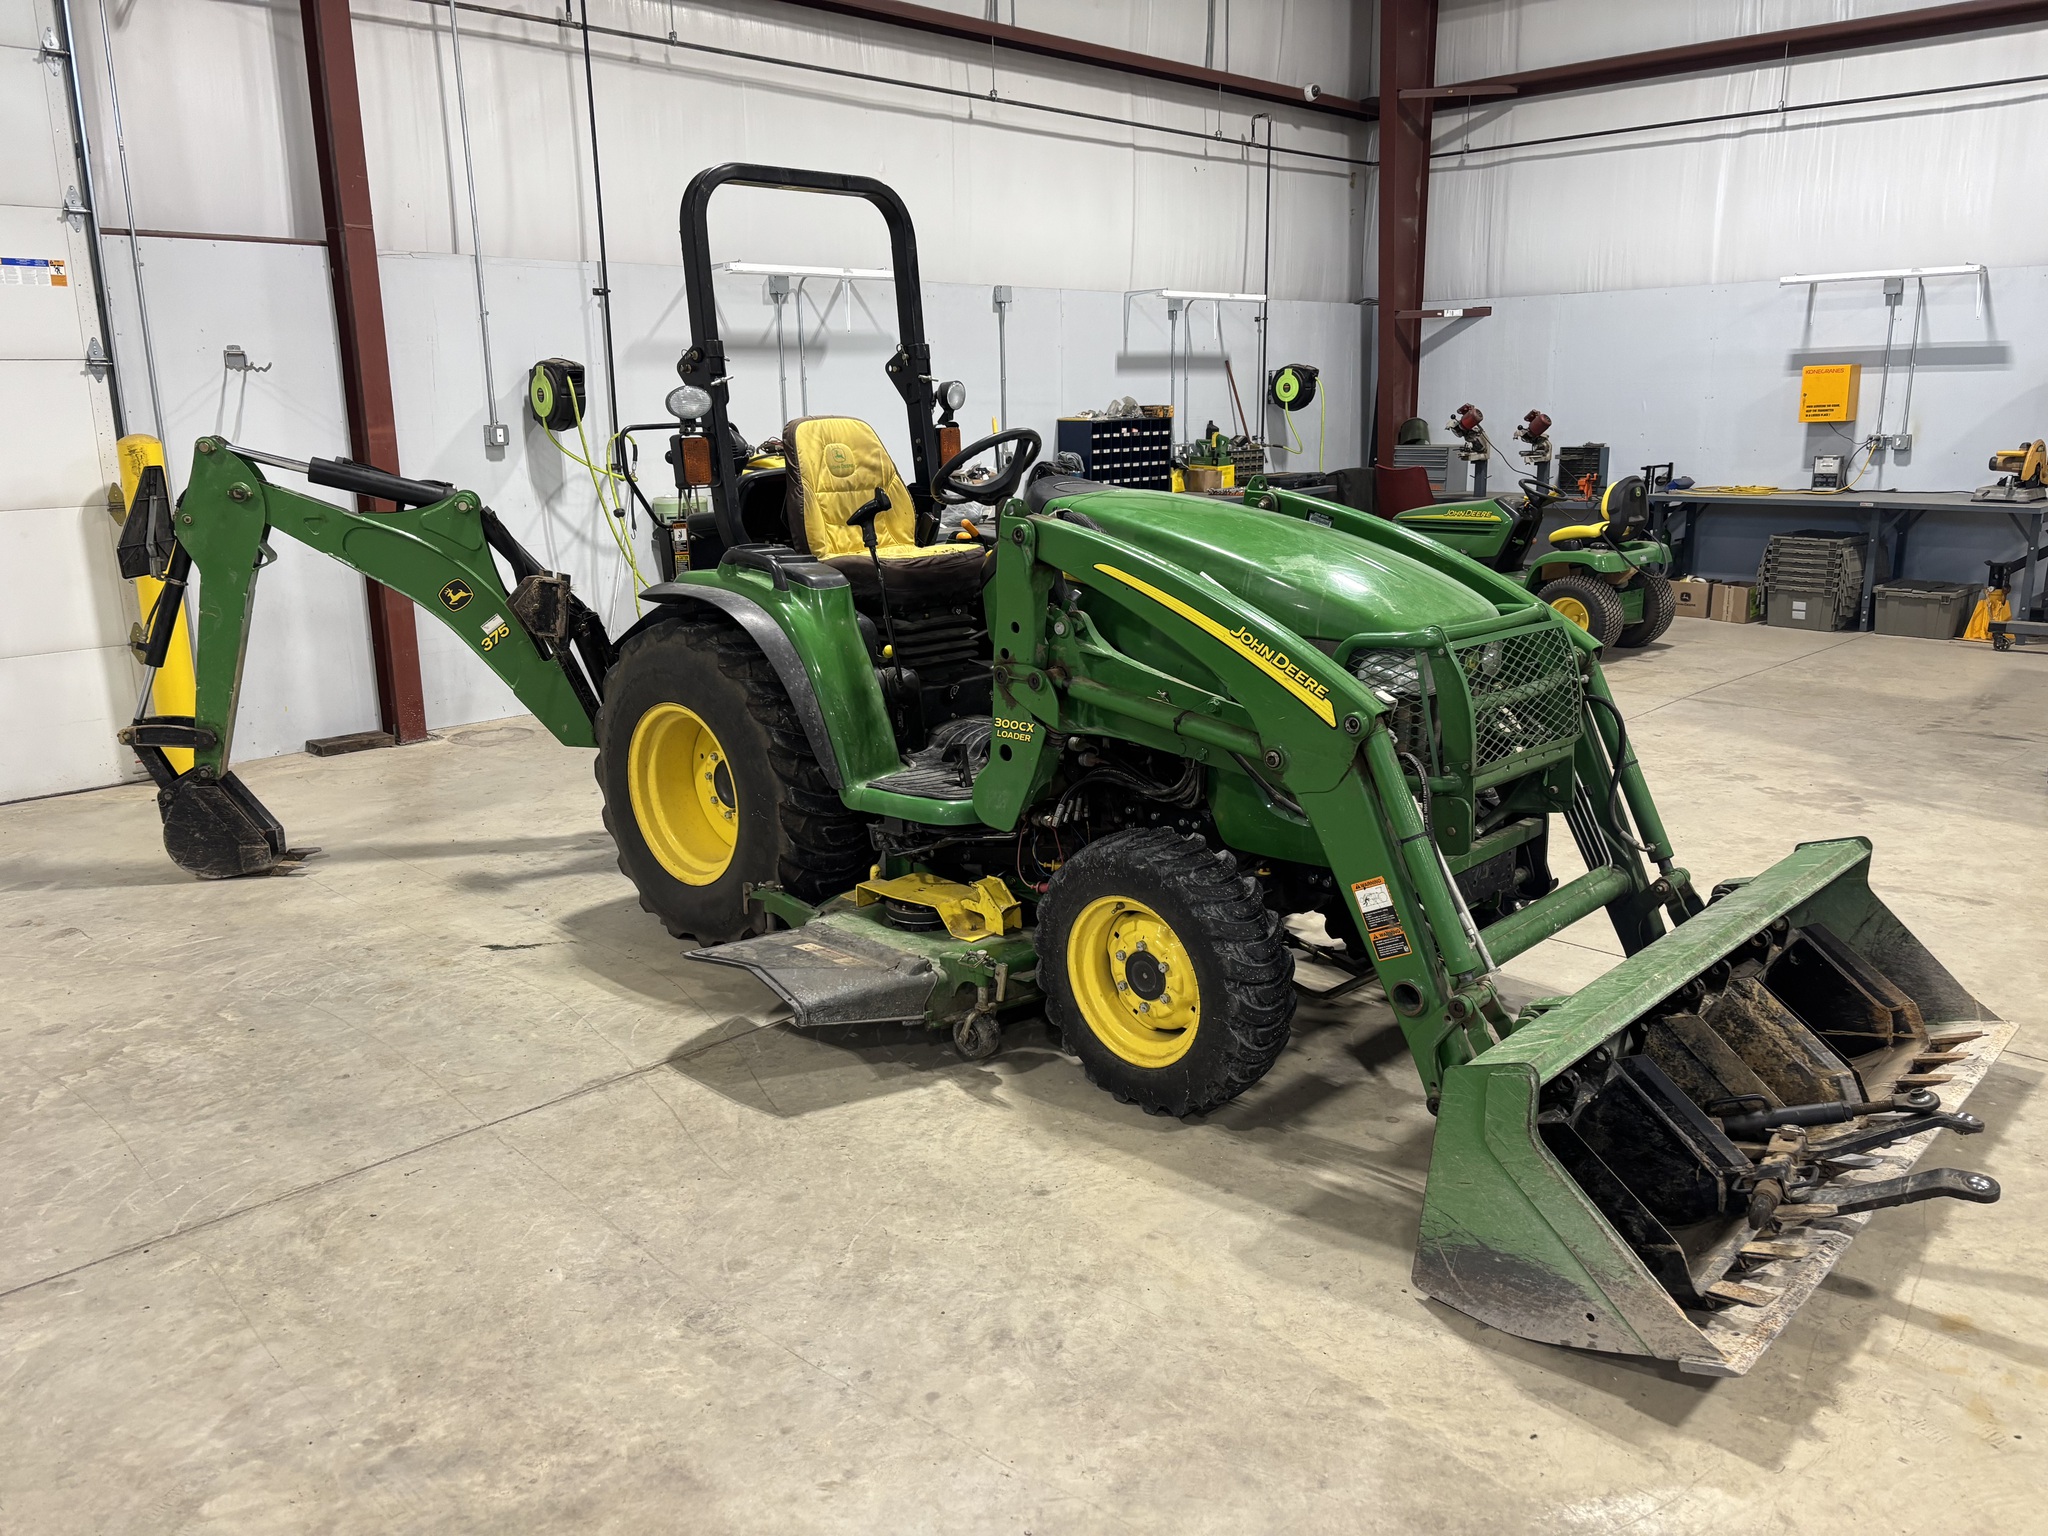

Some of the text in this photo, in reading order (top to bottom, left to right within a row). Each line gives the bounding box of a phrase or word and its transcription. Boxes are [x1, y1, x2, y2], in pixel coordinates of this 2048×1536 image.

[1444, 509, 1493, 518] JOHN DEERE
[481, 623, 510, 651] 375
[1230, 625, 1330, 700] JOHN DEERE
[994, 717, 1035, 733] 300CX
[996, 729, 1032, 742] LOADER
[1360, 878, 1382, 888] WARNING
